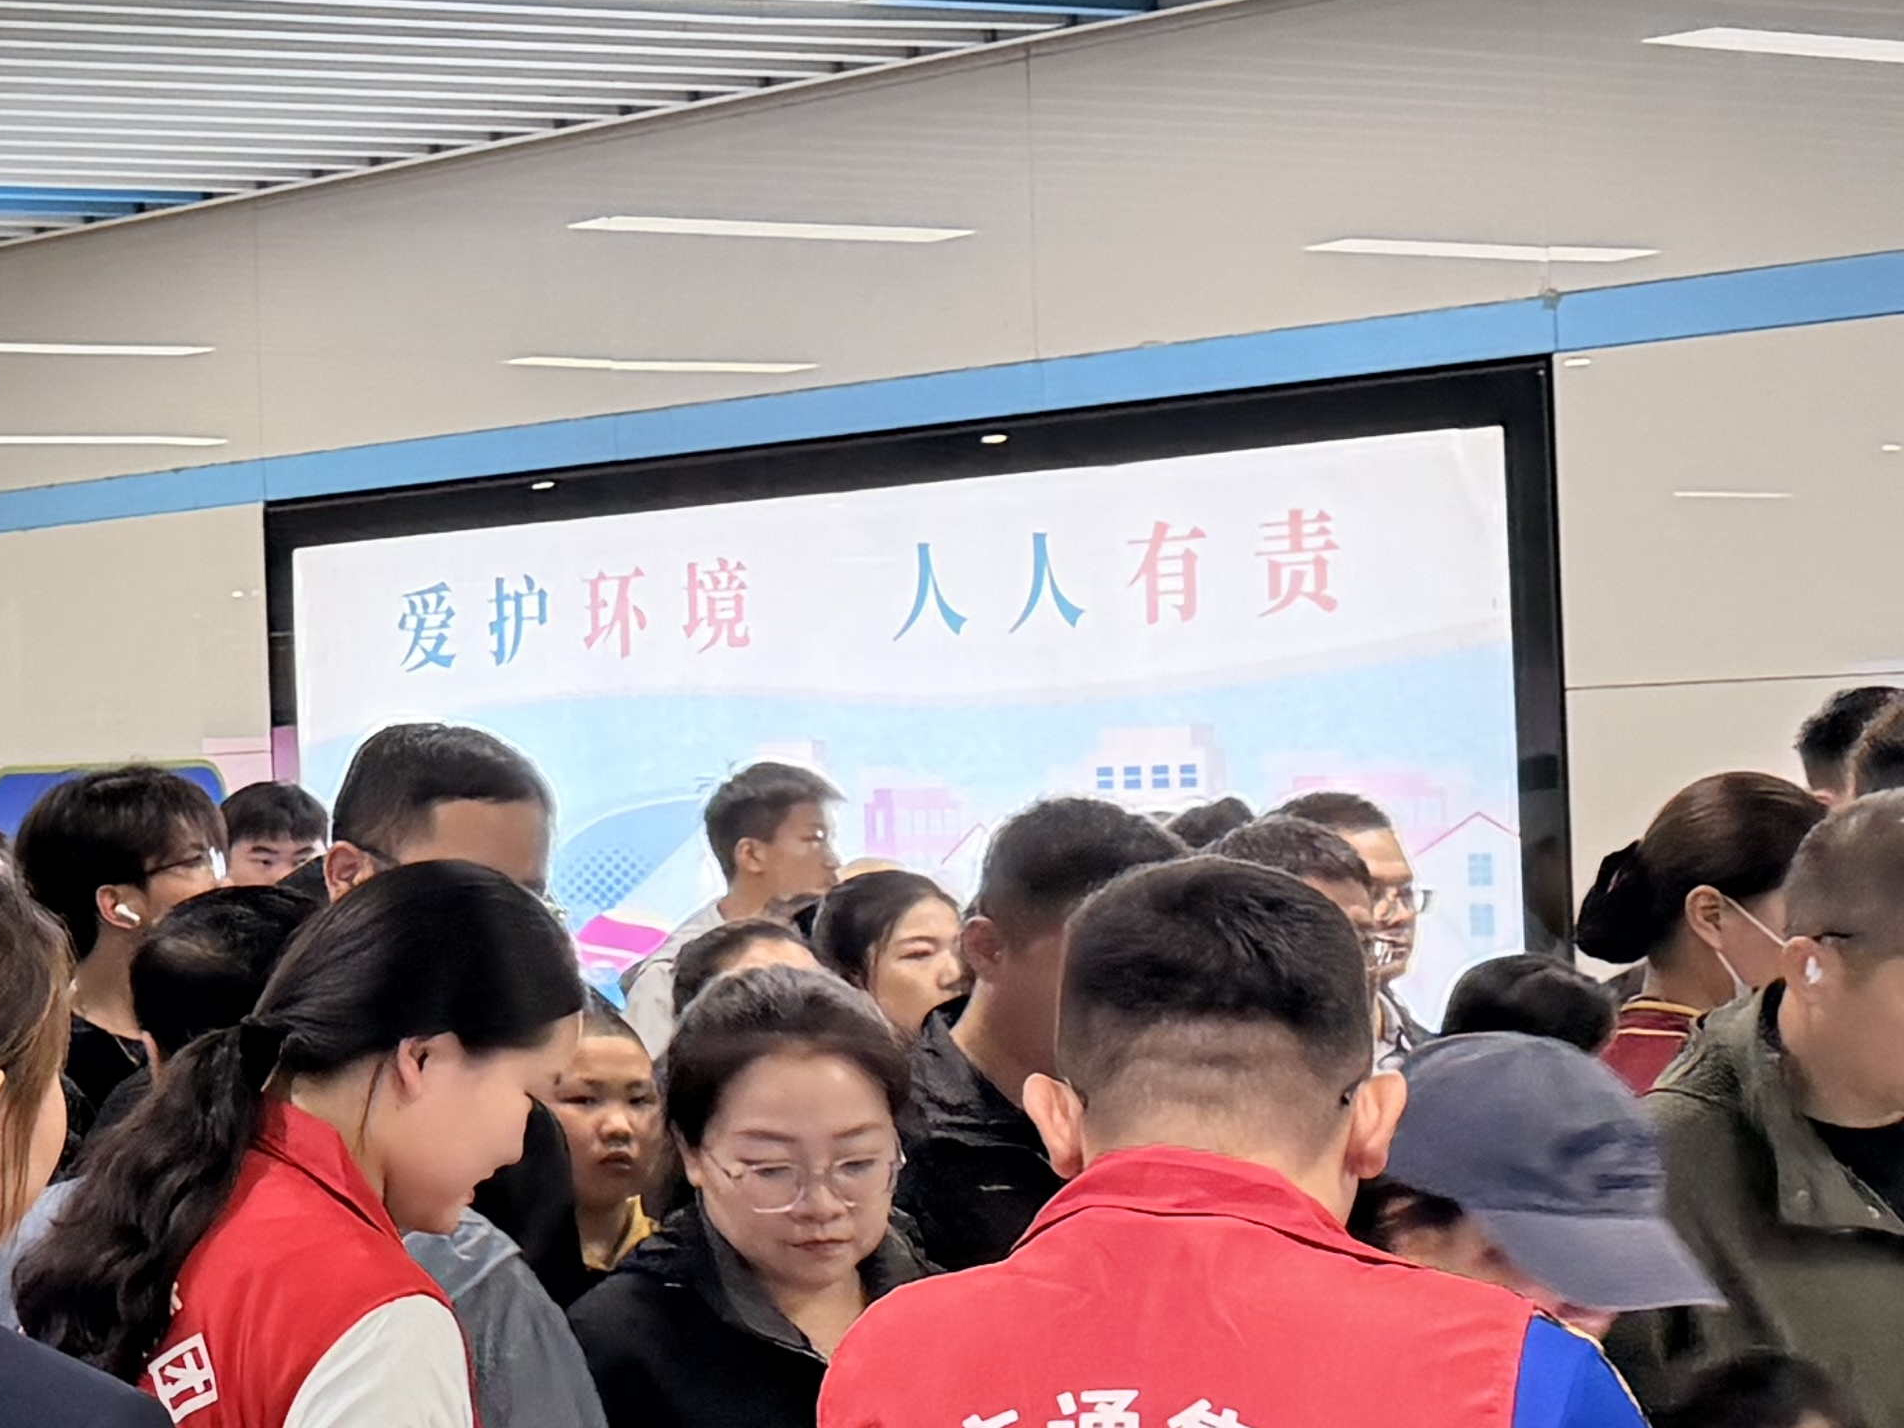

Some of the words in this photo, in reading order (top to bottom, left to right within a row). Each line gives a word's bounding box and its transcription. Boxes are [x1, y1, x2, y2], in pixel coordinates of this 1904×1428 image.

[396, 556, 752, 674] 爱护环境
[891, 507, 1341, 643] 人人有责
